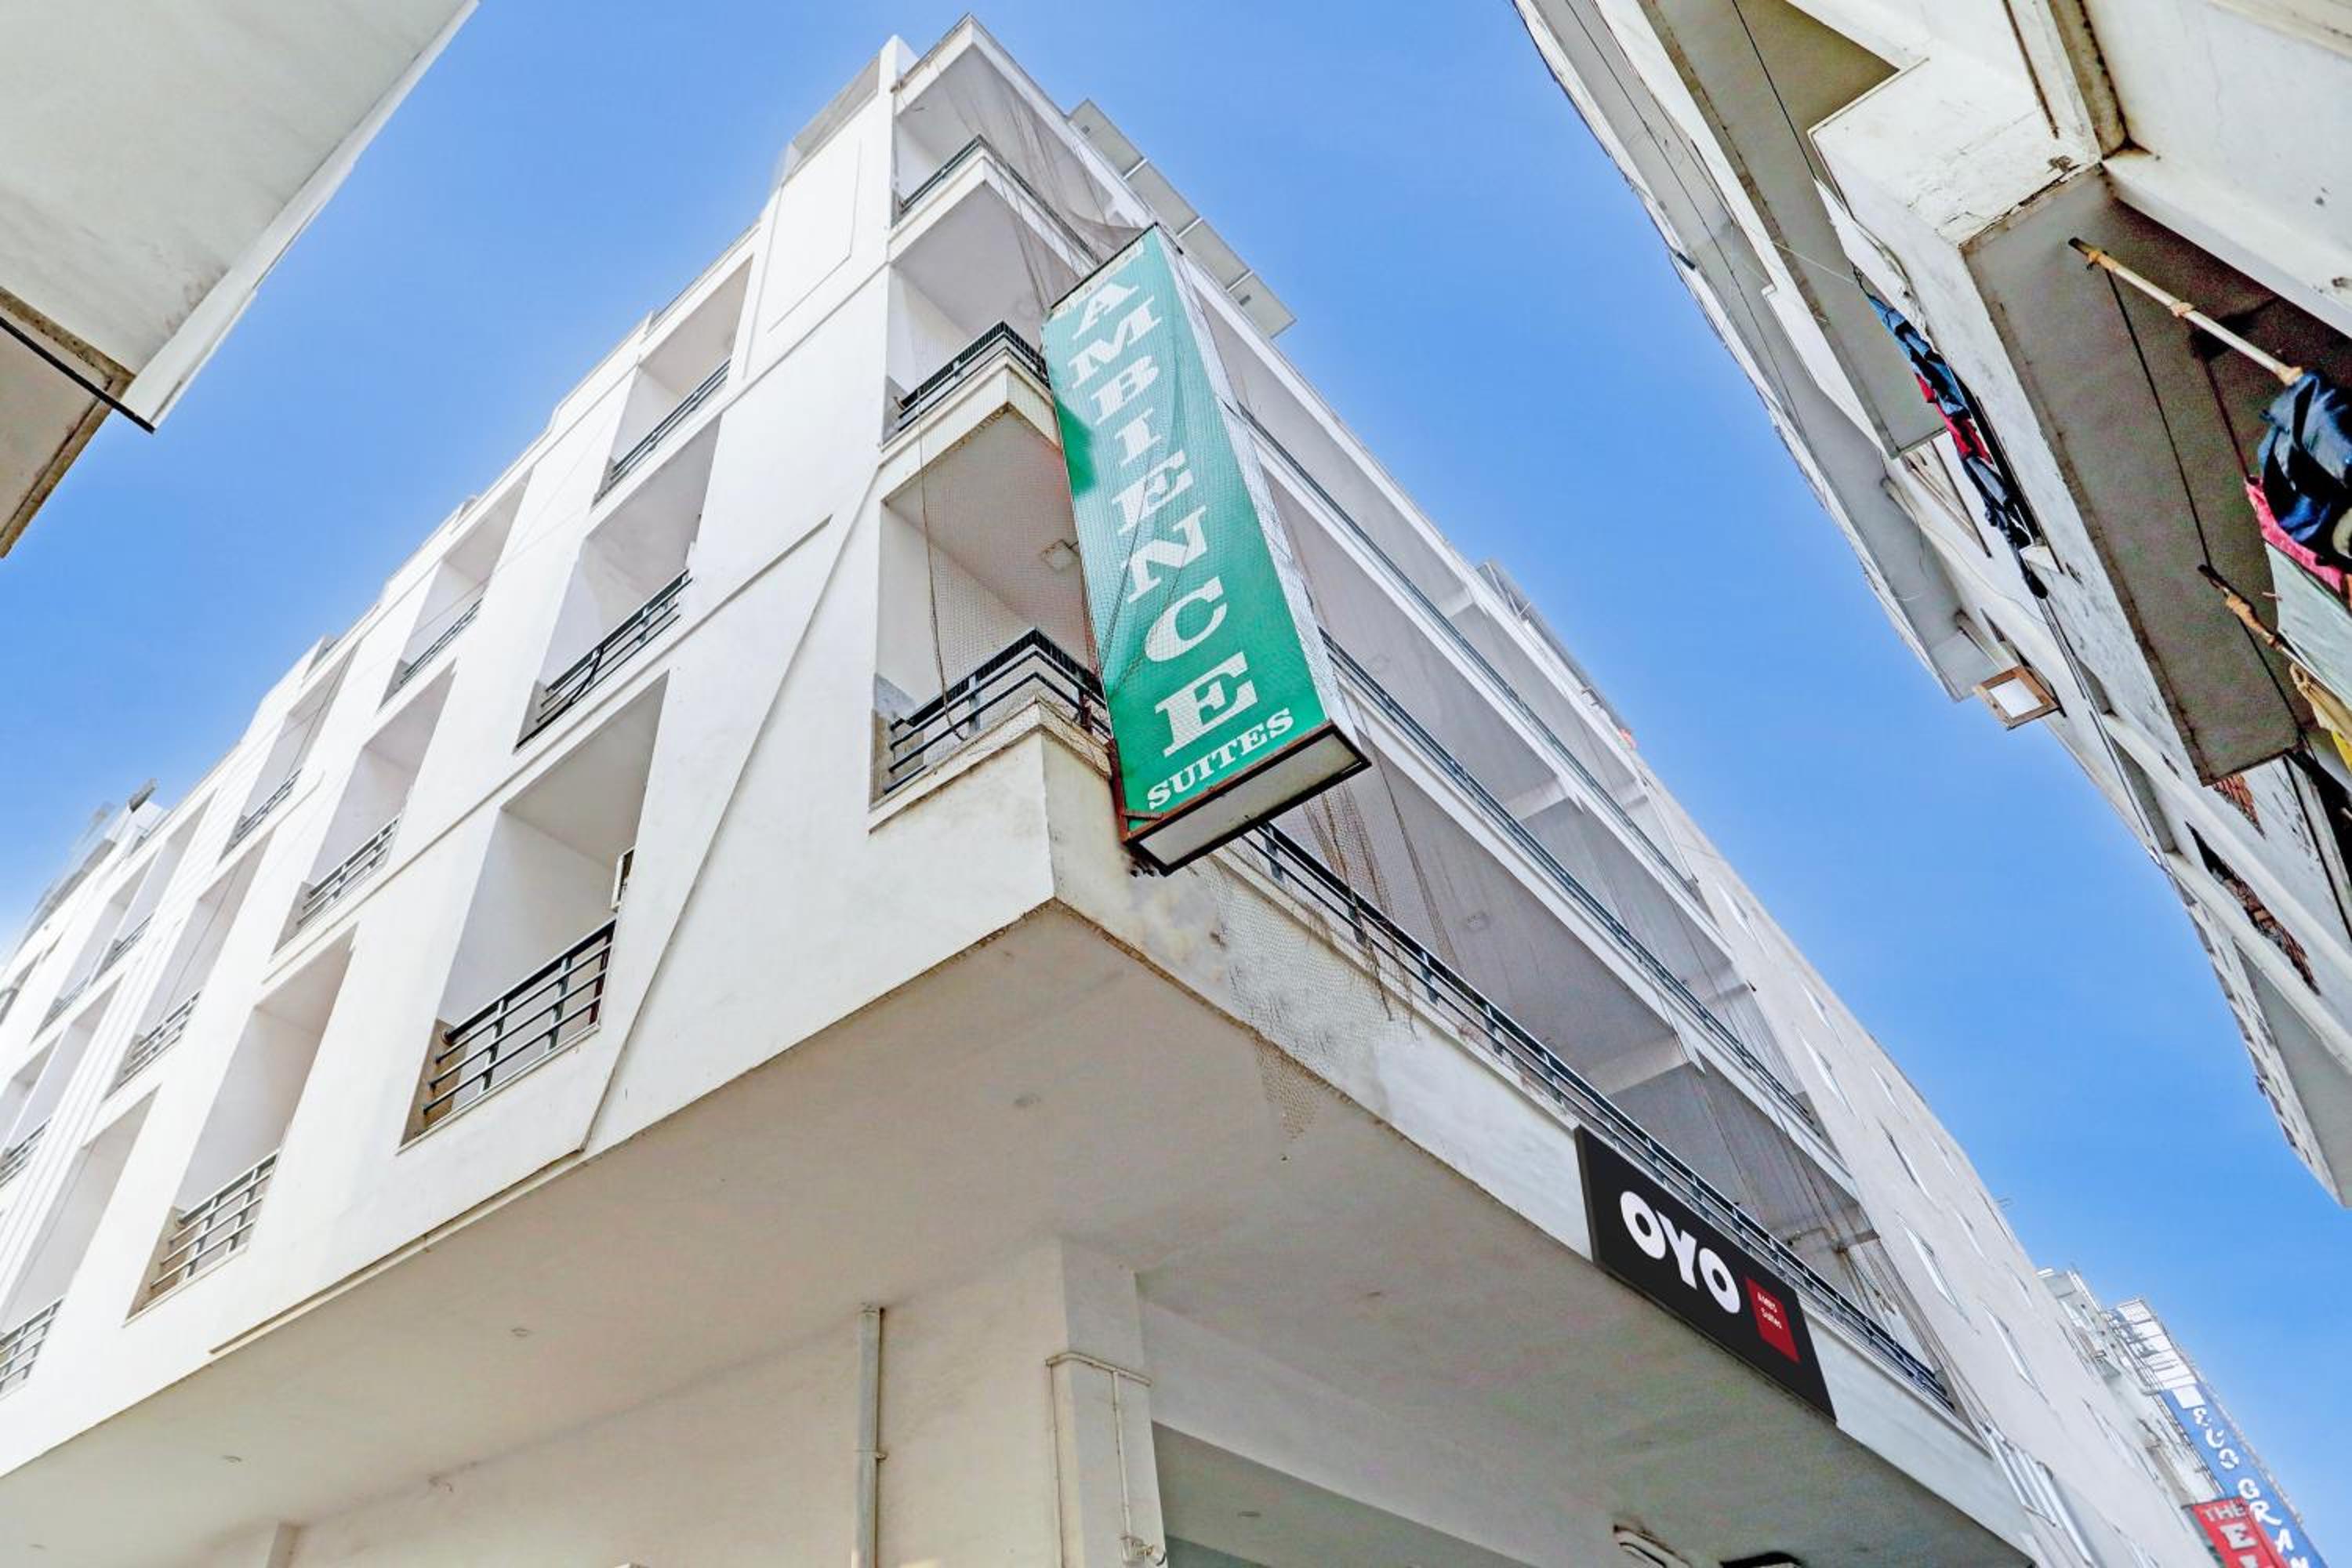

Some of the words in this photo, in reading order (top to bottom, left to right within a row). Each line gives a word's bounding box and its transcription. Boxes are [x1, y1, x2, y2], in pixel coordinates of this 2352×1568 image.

[1072, 282, 1258, 758] AMBIENCE
[1147, 707, 1294, 810] SUITES
[1620, 1190, 1741, 1314] OYO
